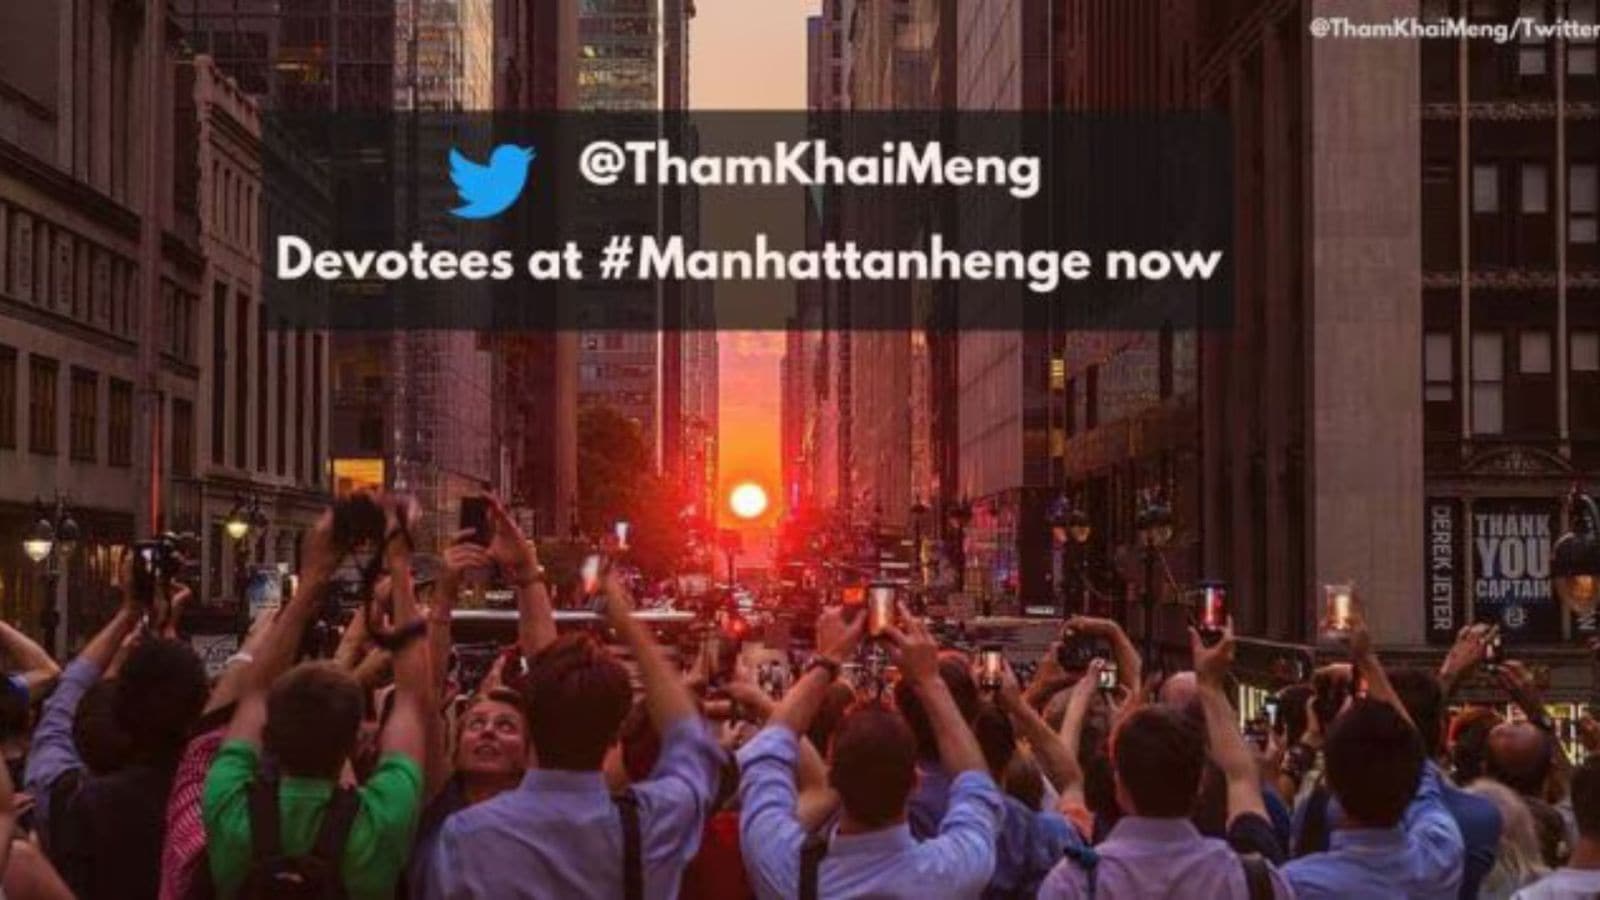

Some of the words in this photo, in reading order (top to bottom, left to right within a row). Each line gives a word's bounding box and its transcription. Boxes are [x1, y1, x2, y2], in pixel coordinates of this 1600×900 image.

[1431, 505, 1452, 570] DEREK
[1475, 513, 1550, 537] THANK
[1475, 537, 1550, 579] YOU
[1431, 573, 1452, 630] JETER
[1475, 579, 1552, 599] CAPTAIN
